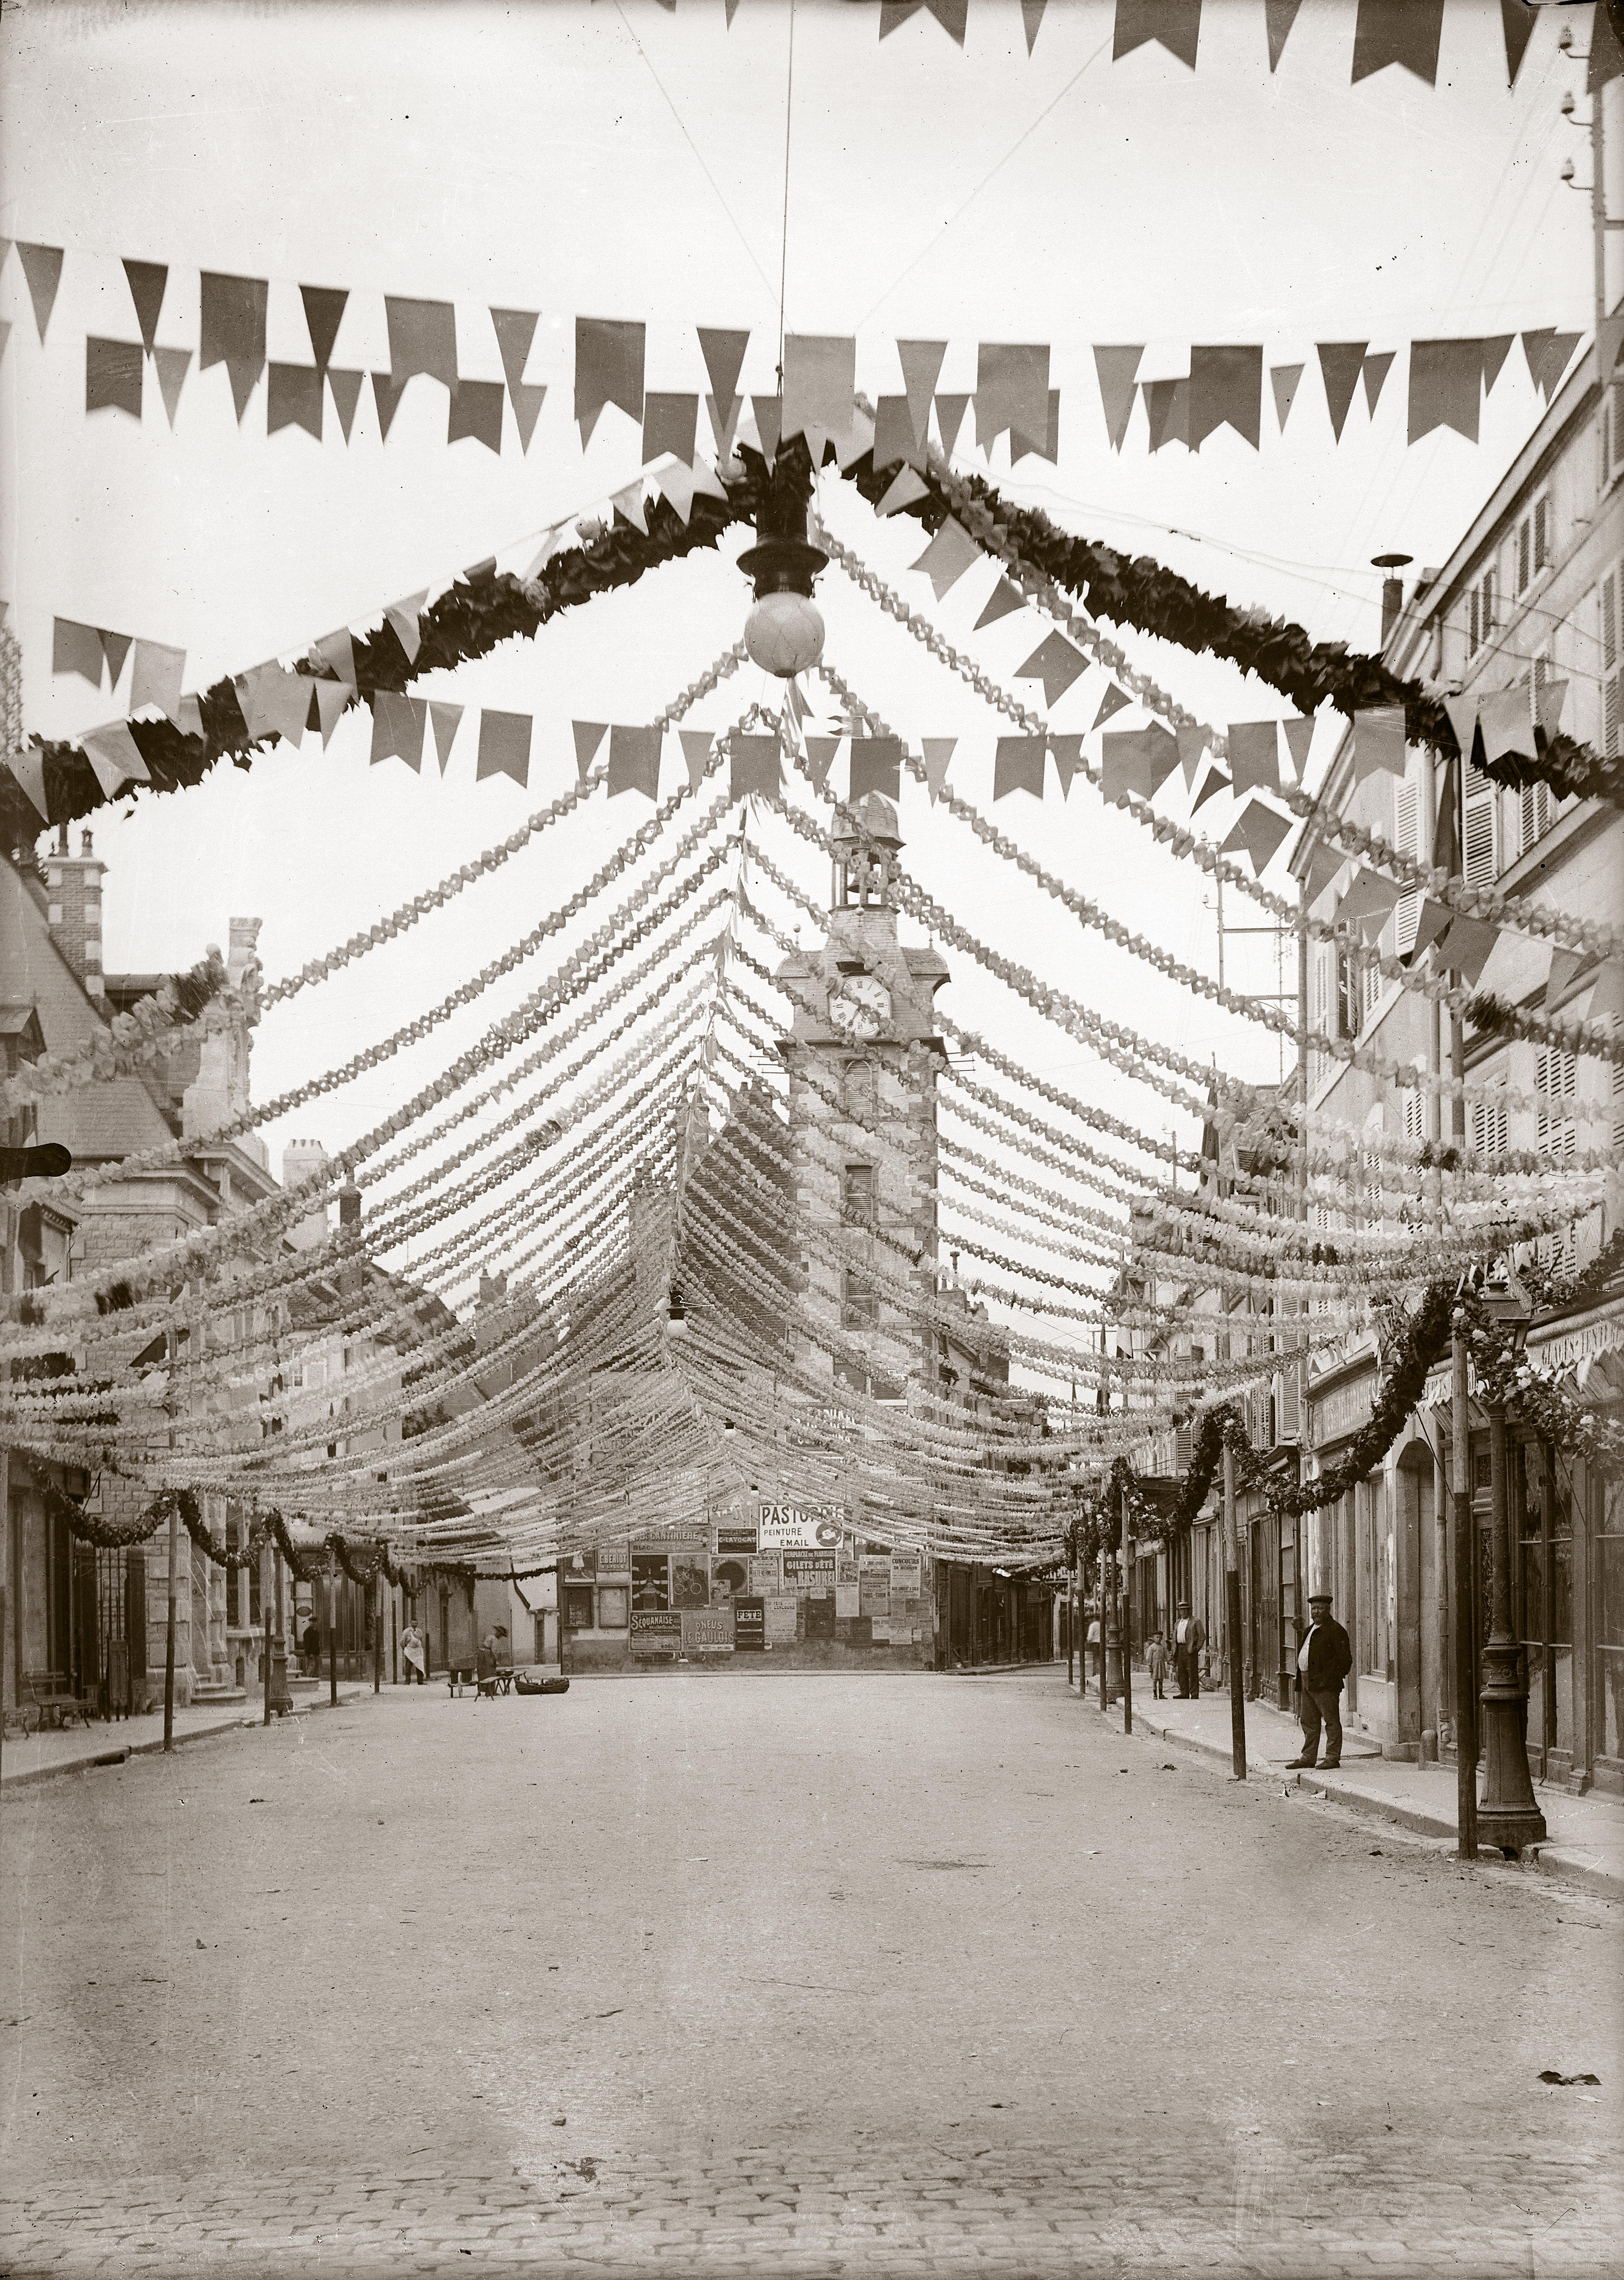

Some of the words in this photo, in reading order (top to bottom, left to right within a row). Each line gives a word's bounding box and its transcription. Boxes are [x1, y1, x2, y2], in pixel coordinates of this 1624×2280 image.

[764, 1527, 802, 1535] PEINTURE
[786, 1560, 813, 1569] GILETS
[695, 1620, 723, 1631] PNEUS
[684, 1631, 692, 1644] LE
[695, 1631, 735, 1644] GAULOIS
